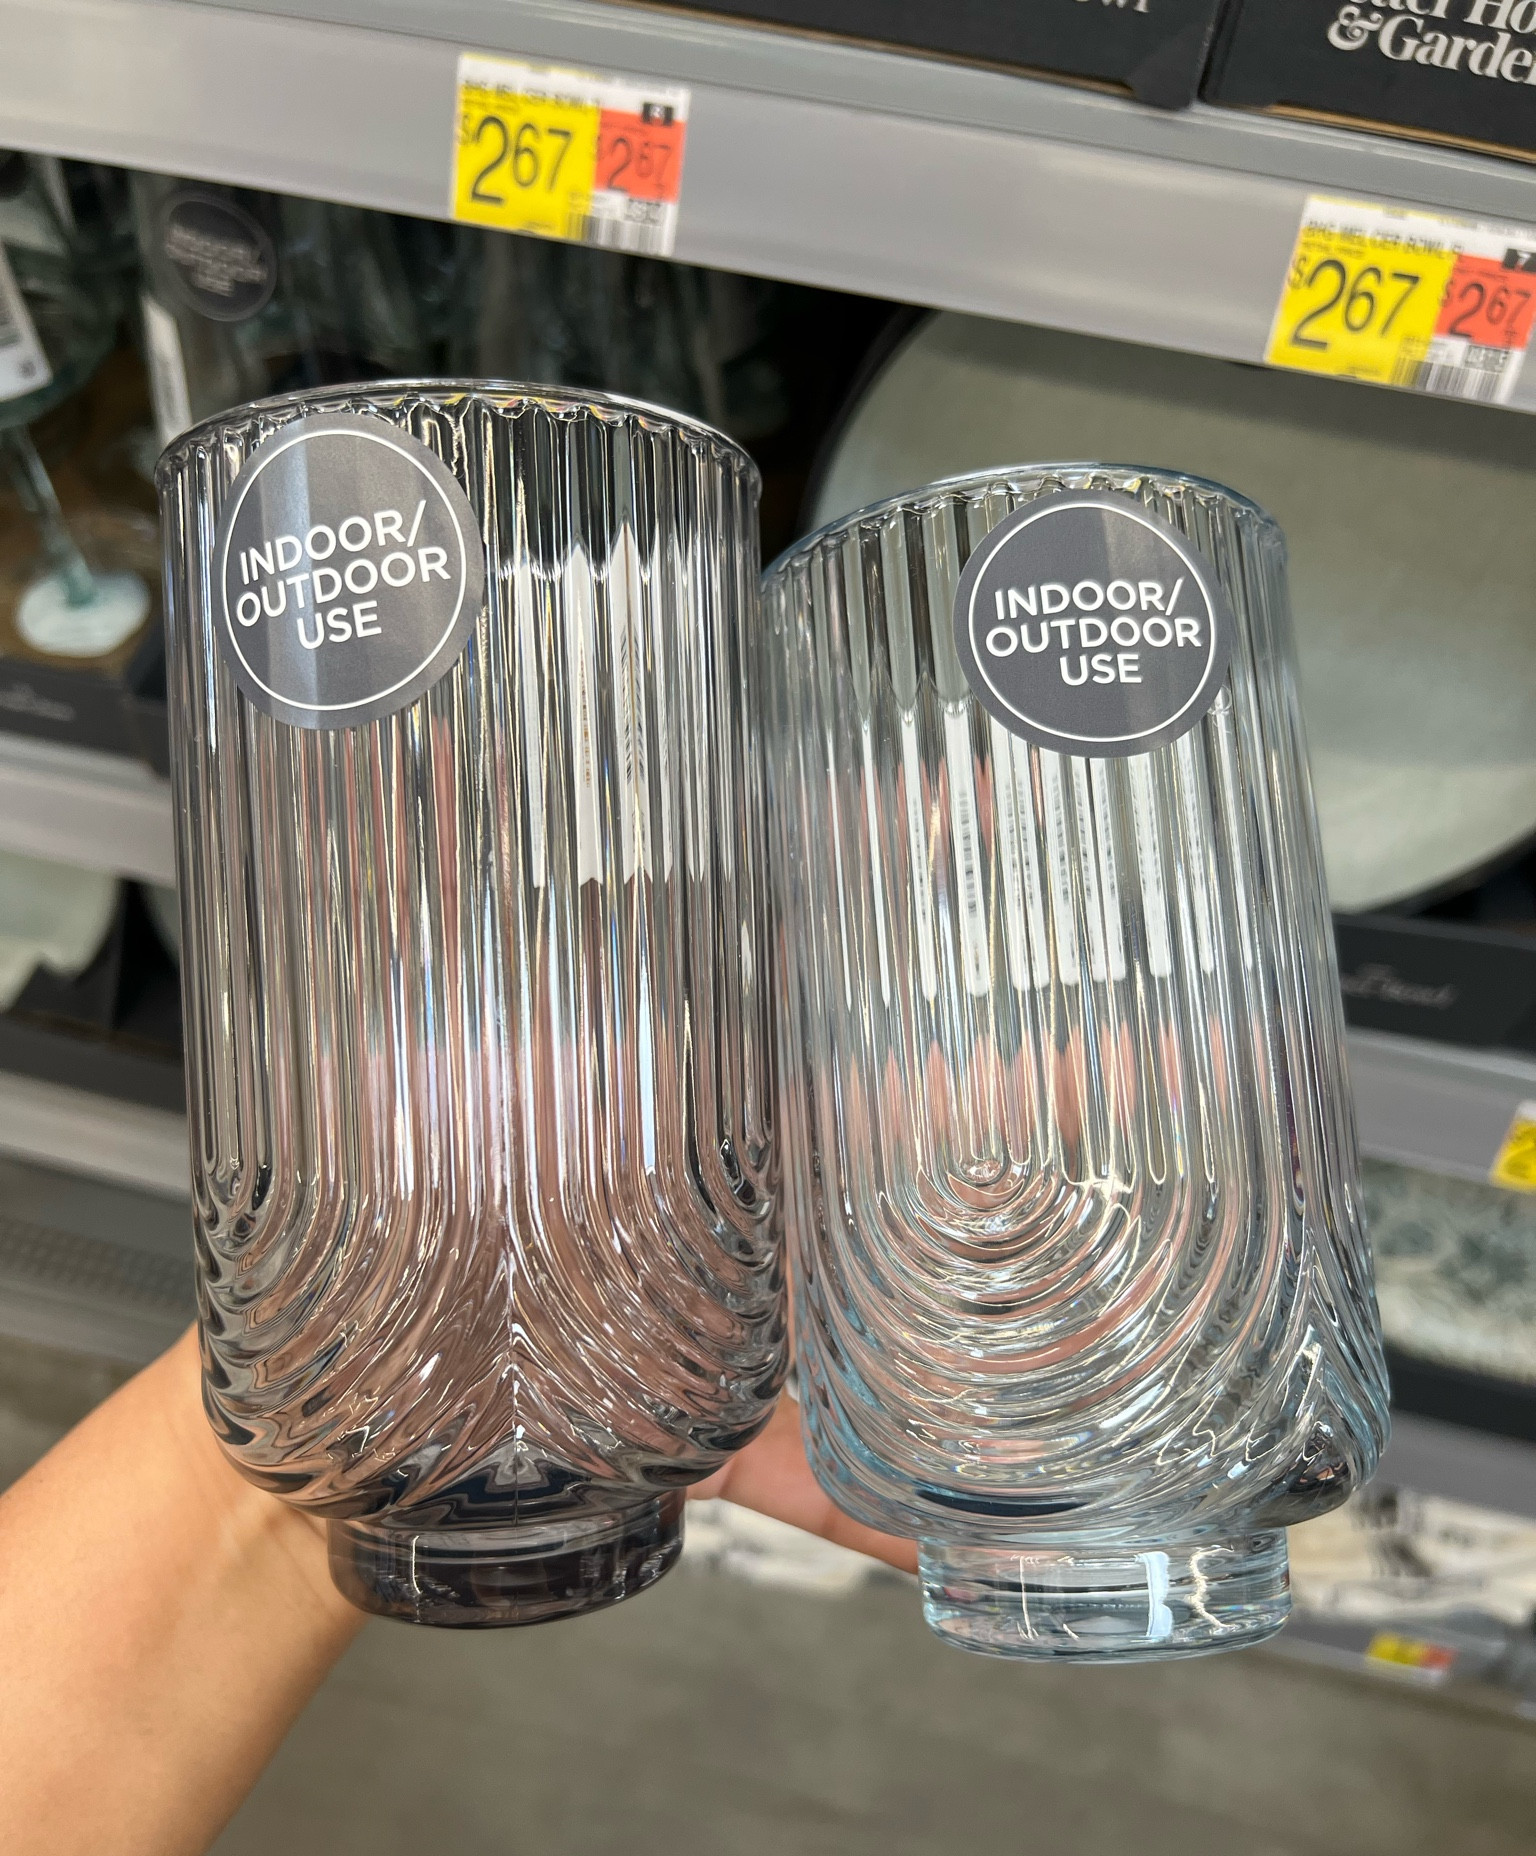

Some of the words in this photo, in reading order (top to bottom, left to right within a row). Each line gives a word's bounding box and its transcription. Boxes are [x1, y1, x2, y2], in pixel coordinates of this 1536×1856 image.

[1327, 4, 1536, 86] &Garde
[240, 499, 427, 585] INDOOR/
[236, 546, 451, 627] OUTDOOR
[994, 576, 1185, 620] INDOOR/
[297, 600, 382, 650] USE
[985, 616, 1202, 658] OUTDOOR
[1059, 653, 1142, 686] USE
